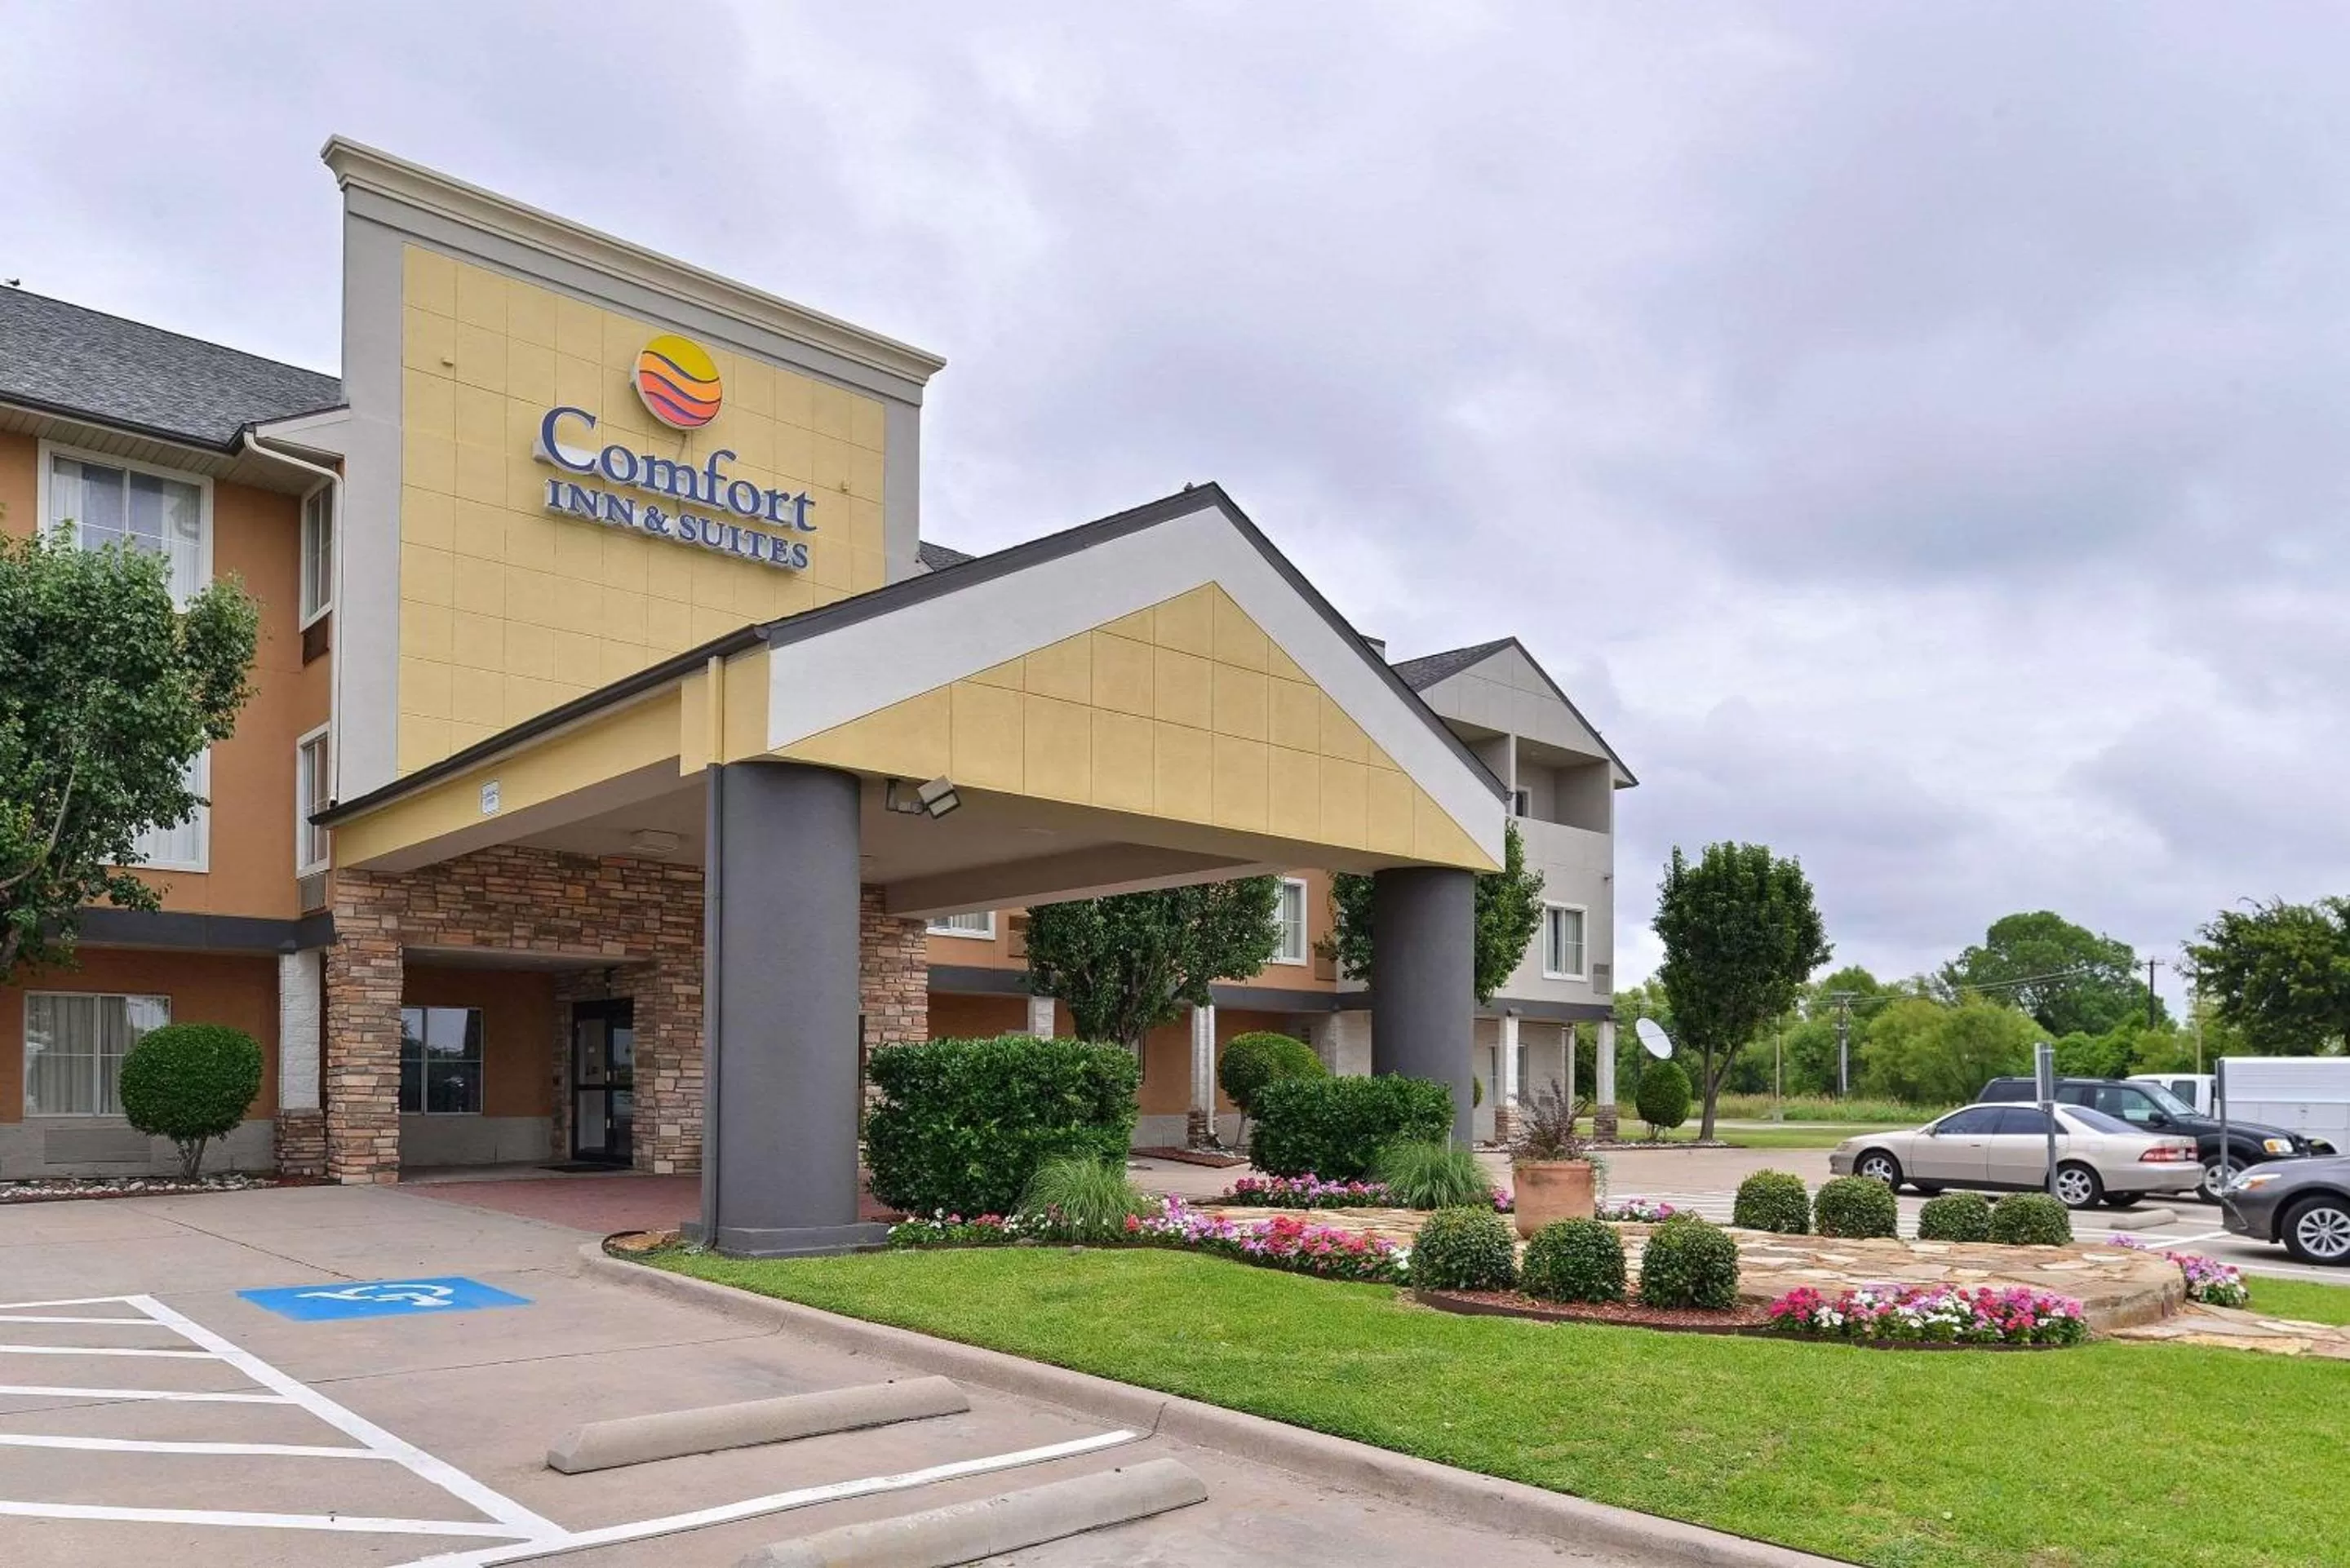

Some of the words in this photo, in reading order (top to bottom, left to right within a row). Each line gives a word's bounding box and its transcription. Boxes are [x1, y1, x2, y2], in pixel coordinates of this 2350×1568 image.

[541, 406, 817, 532] Comfort
[548, 479, 635, 526] INN
[644, 505, 669, 535] &
[679, 514, 809, 569] SUITES
